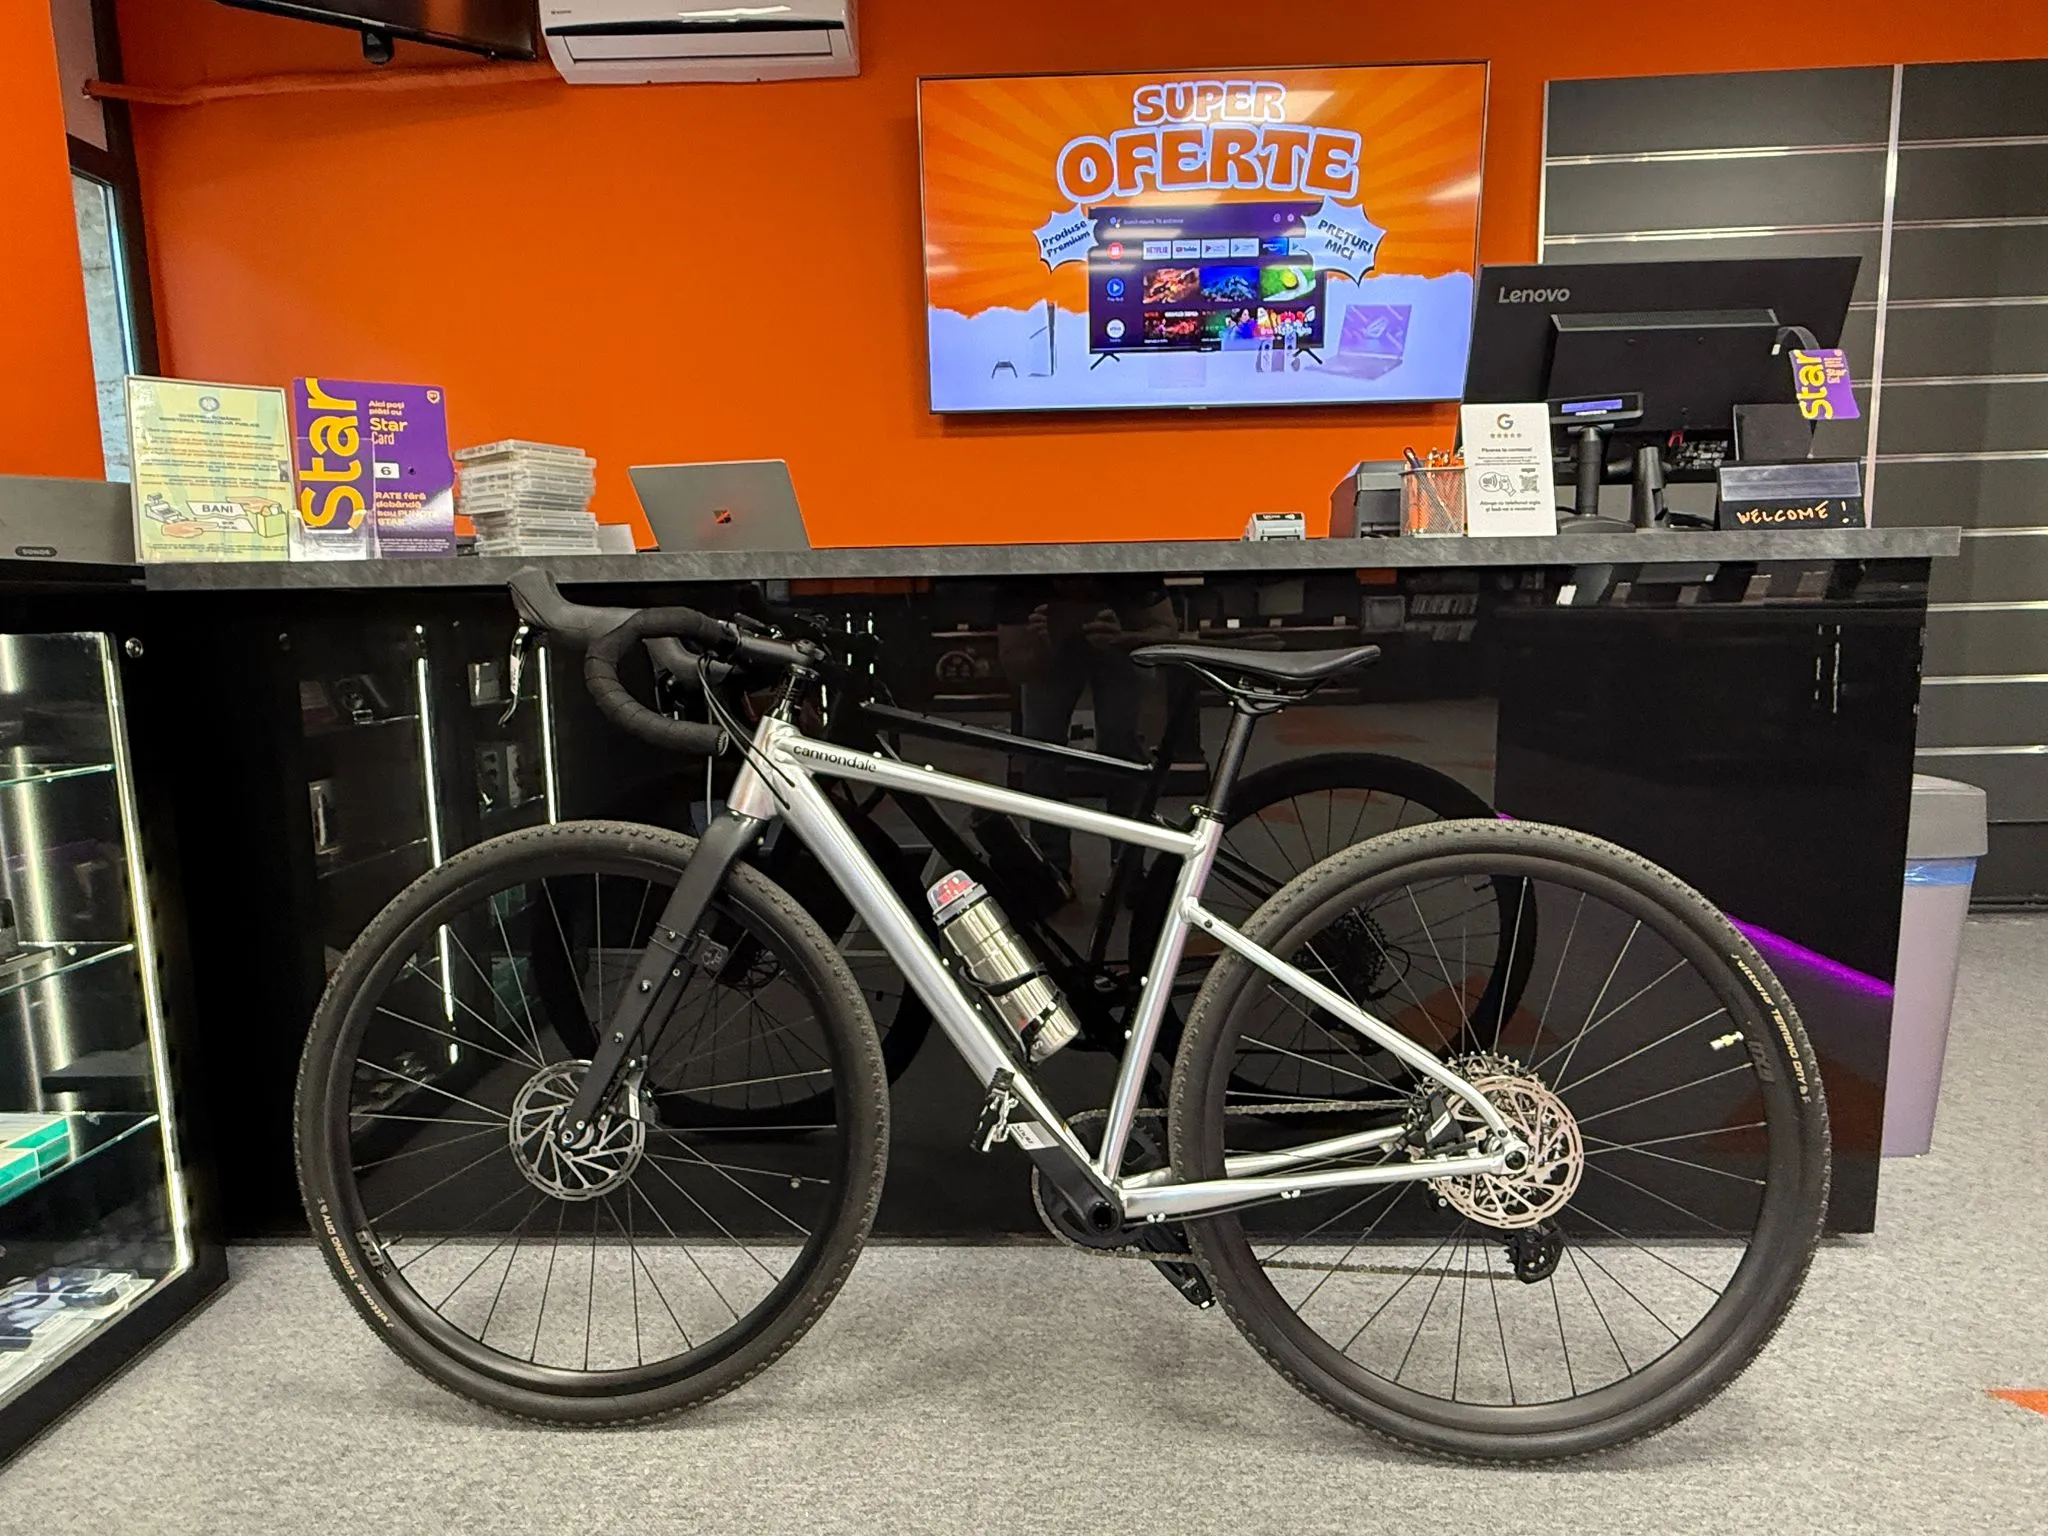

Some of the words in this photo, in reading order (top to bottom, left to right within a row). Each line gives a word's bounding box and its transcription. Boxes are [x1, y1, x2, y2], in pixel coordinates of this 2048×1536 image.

[1133, 81, 1286, 125] SUPER
[1058, 124, 1360, 201] OFERTE
[1042, 220, 1087, 248] Produse
[1046, 231, 1090, 257] Premium
[1325, 239, 1355, 261] MICI
[1498, 285, 1570, 304] Lenovo
[368, 400, 386, 408] Aici
[369, 417, 408, 432] Star
[371, 431, 395, 445] Card
[380, 466, 391, 476] 6
[375, 491, 402, 500] RATE
[202, 504, 234, 513] BANI
[1736, 503, 1830, 525] WELCOME
[793, 745, 877, 773] cannondale
[1771, 1007, 1800, 1059] TERRENO
[1792, 1059, 1808, 1086] DRY
[321, 1213, 337, 1236] DRY
[331, 1236, 358, 1281] TERRENO
